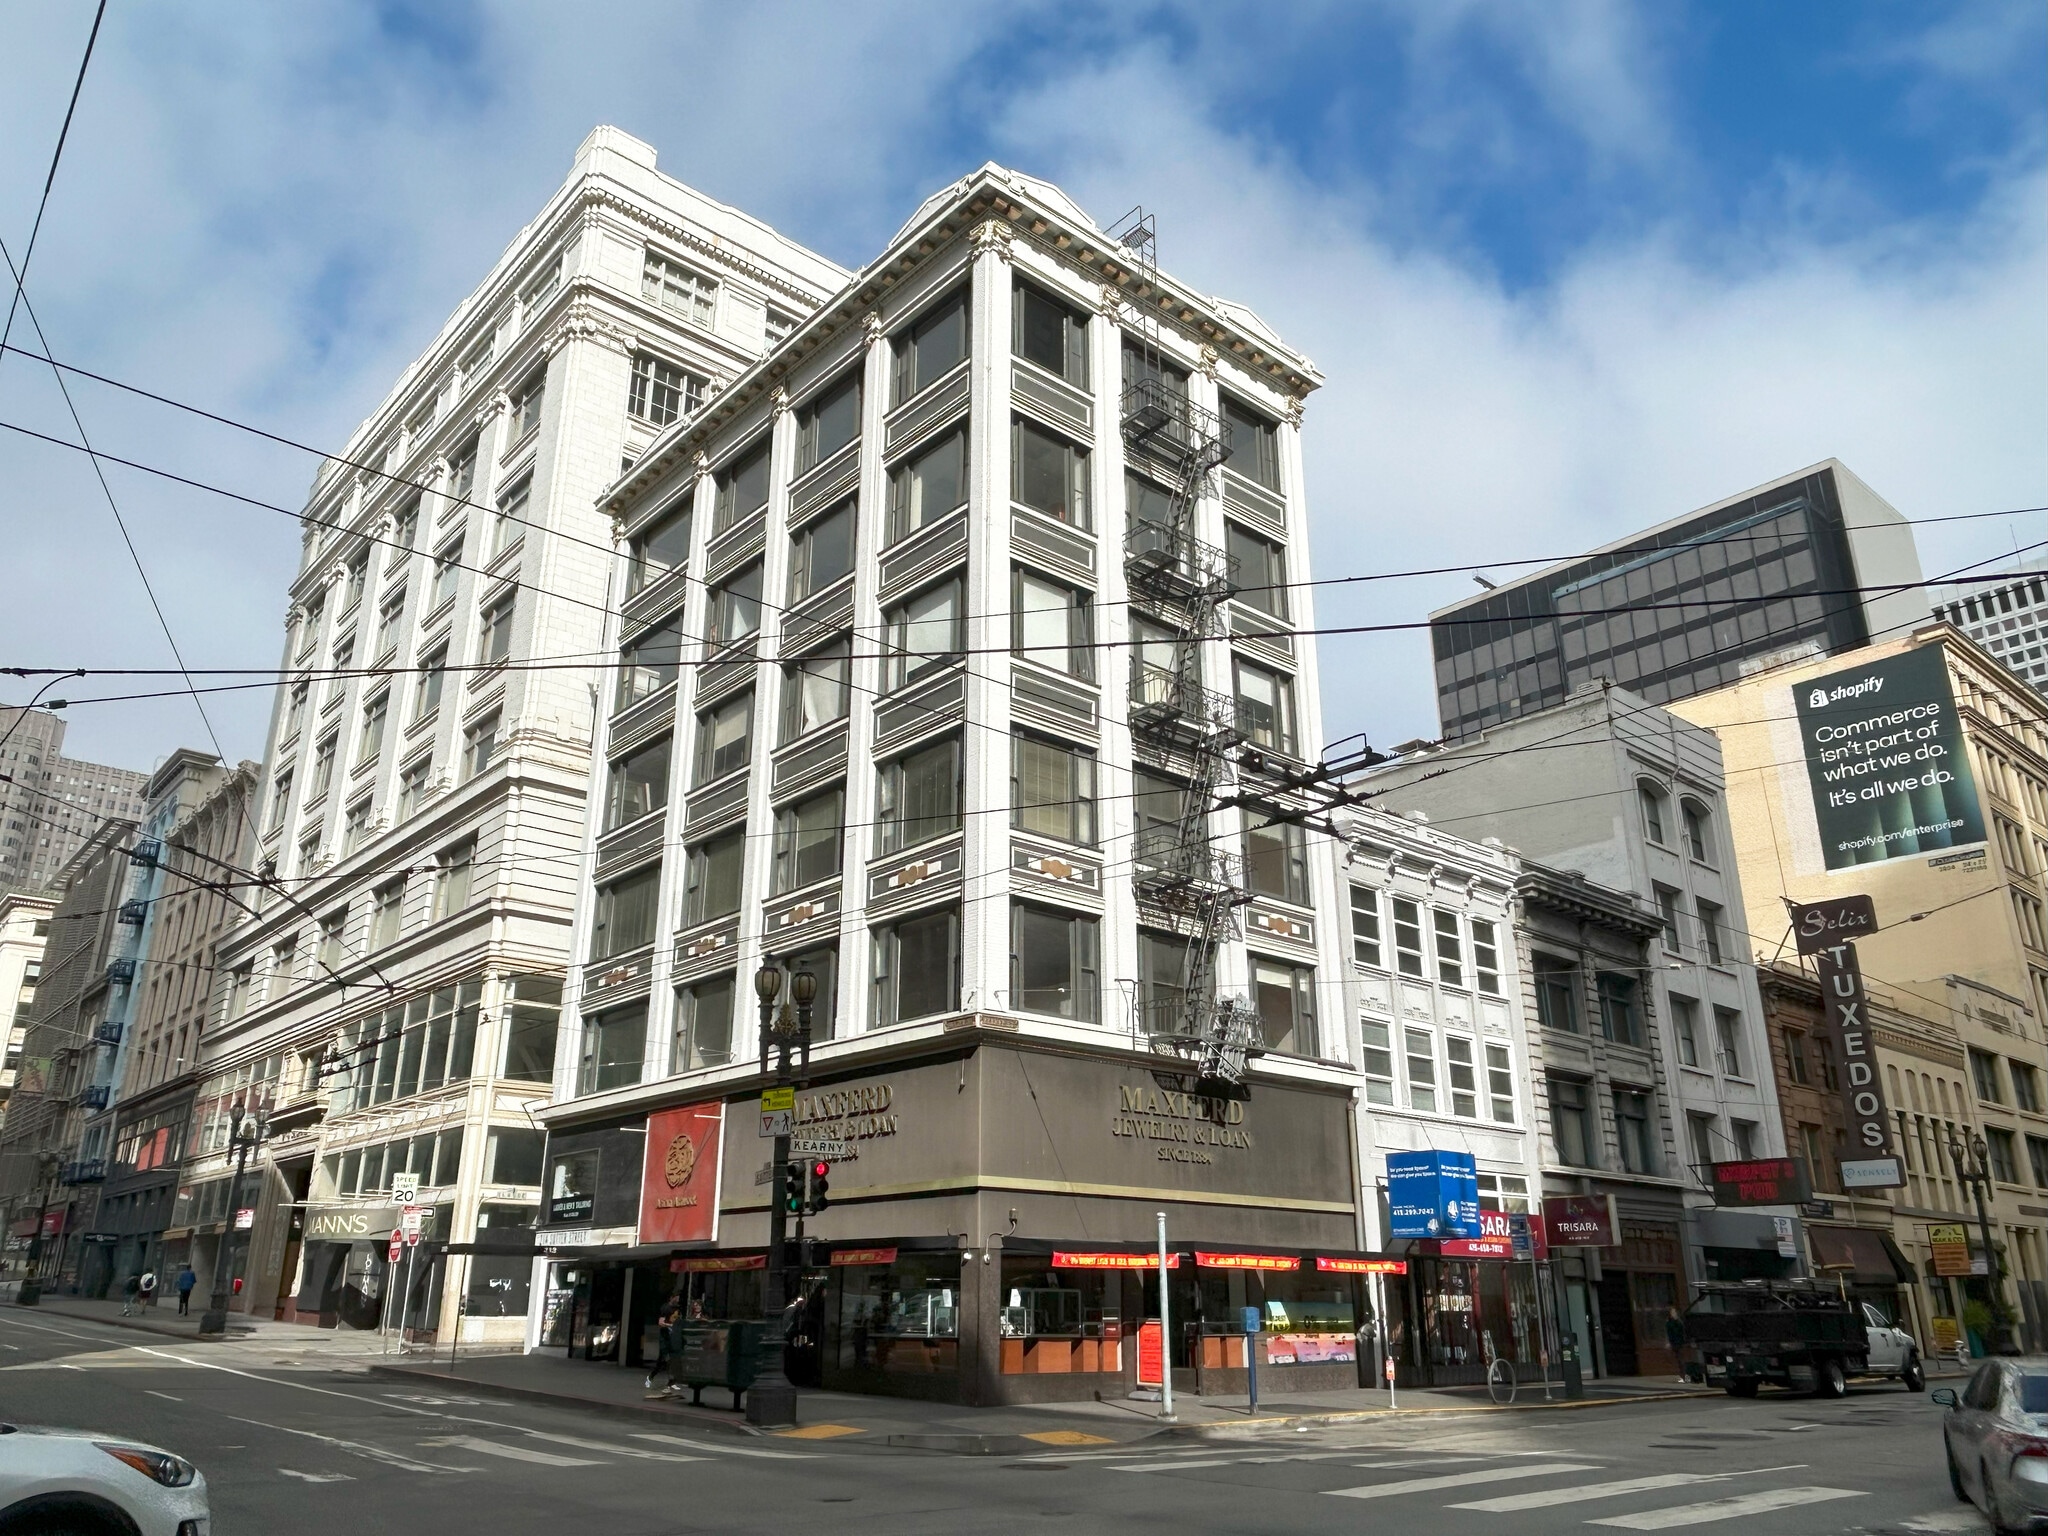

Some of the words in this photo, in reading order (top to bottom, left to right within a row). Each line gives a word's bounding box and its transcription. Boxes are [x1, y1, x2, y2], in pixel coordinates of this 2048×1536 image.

[1830, 676, 1884, 701] shopify
[1815, 702, 1940, 743] Commerce
[1820, 740, 1862, 763] isn't
[1865, 728, 1914, 755] part
[1916, 719, 1940, 739] of
[1823, 757, 1878, 782] what
[1880, 751, 1911, 768] we
[1914, 742, 1948, 760] do.
[1829, 788, 1857, 808] It's
[1860, 780, 1884, 800] all
[1886, 778, 1918, 794] we
[1920, 768, 1955, 786] do.
[1838, 818, 1964, 851] shopify.com/enterprise
[1801, 909, 1869, 937] Selix
[1828, 945, 1884, 1147] TUXEDOS
[792, 1084, 894, 1122] MAXFERD
[1120, 1085, 1244, 1125] MAXFERD
[858, 1114, 899, 1140] LOAN
[1112, 1117, 1189, 1143] JEWELRY
[1194, 1126, 1206, 1145] &
[1208, 1127, 1250, 1150] LOAN
[793, 1140, 844, 1153] KEARNY
[394, 1190, 414, 1202] 20
[1557, 1222, 1599, 1233] TRISARA
